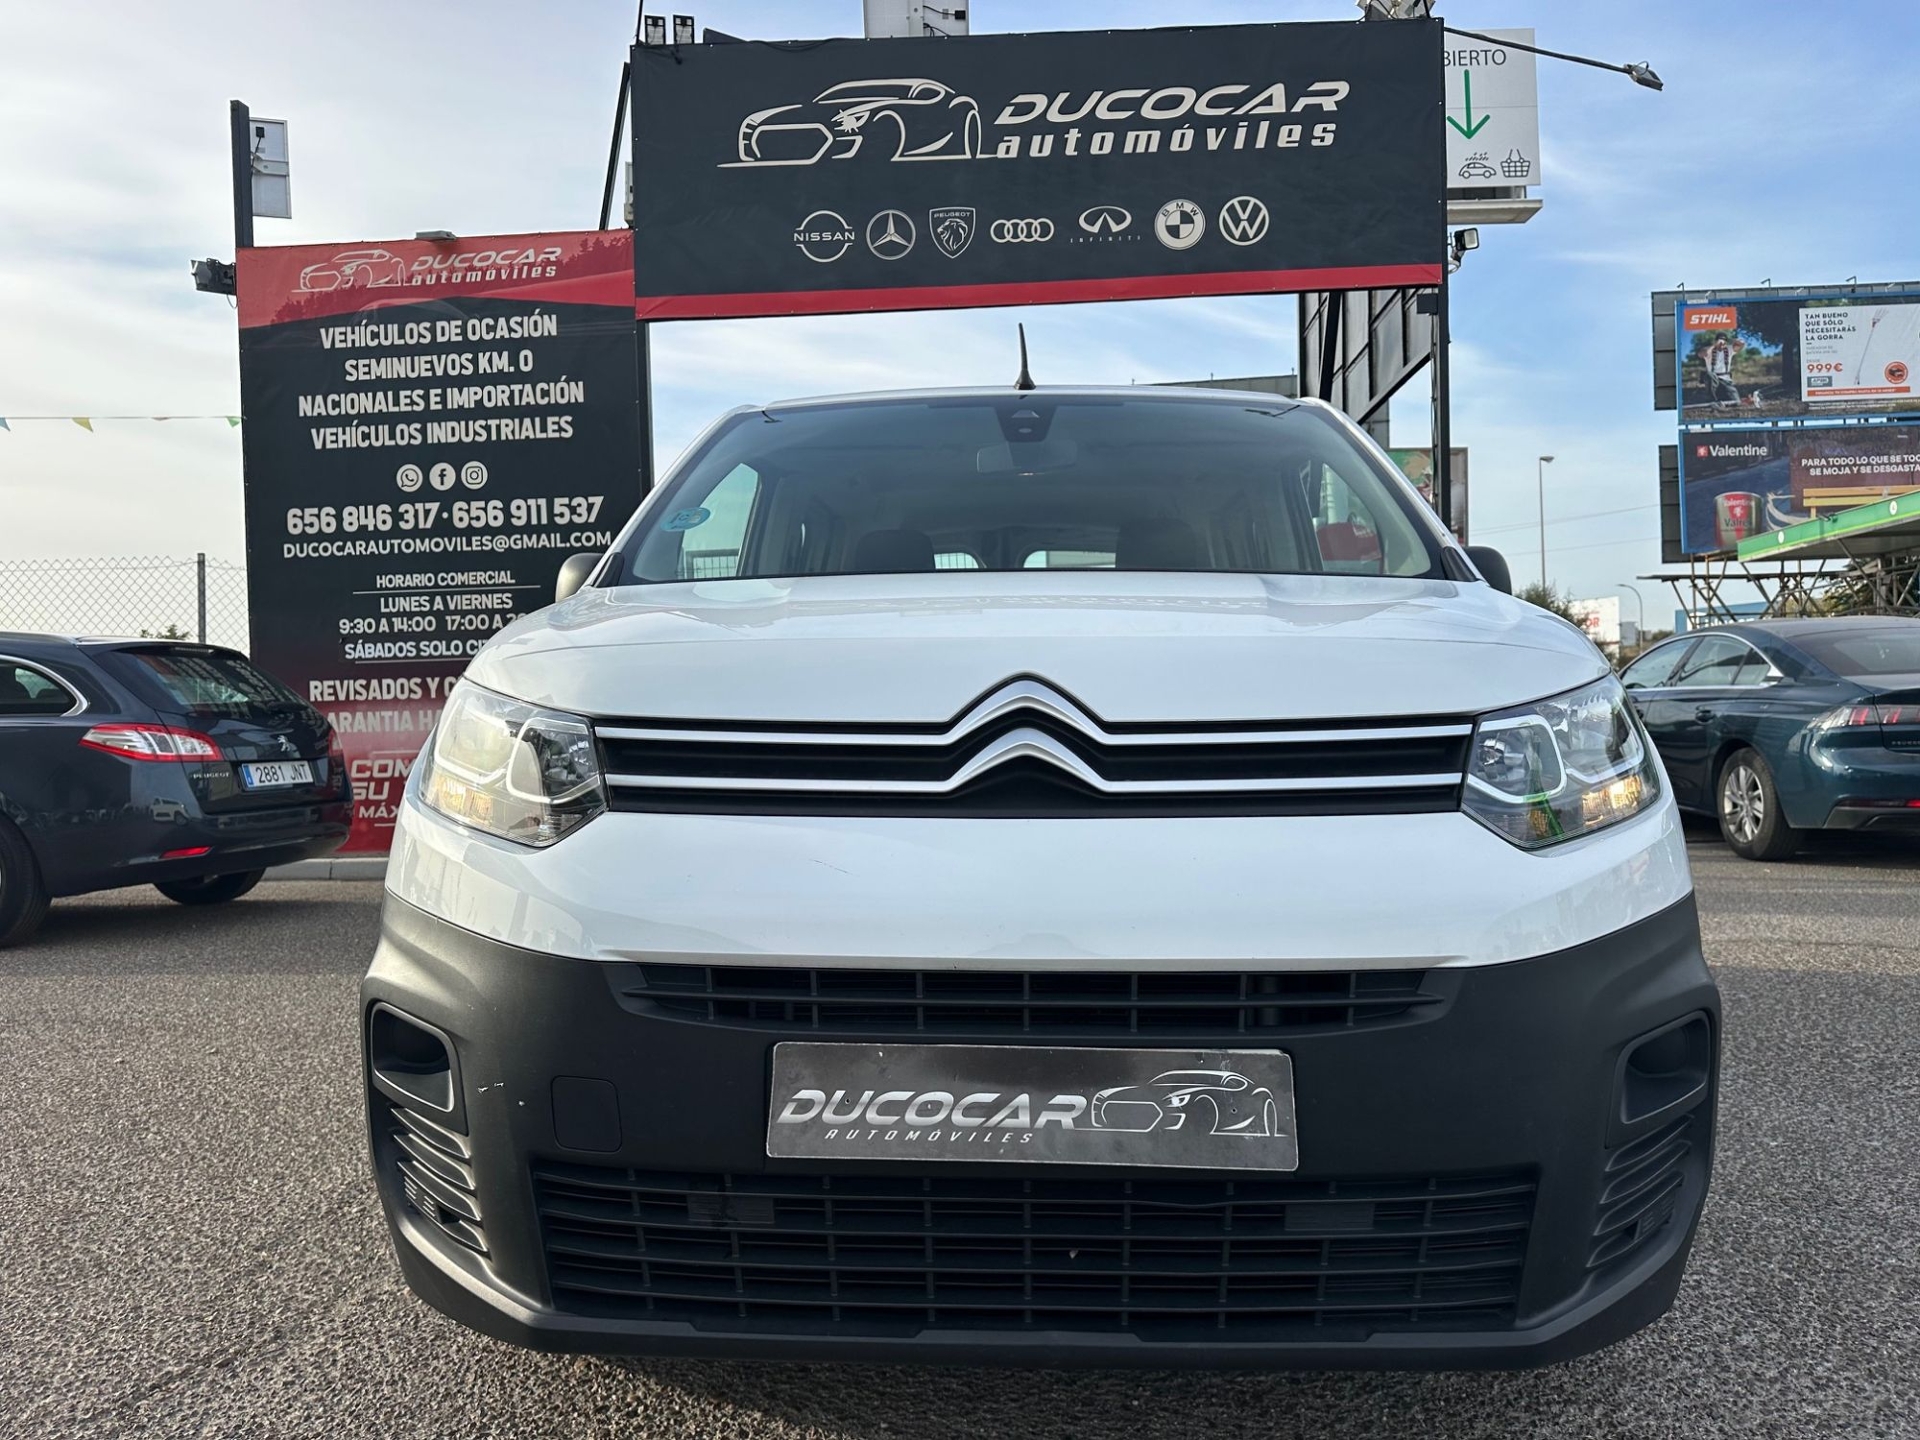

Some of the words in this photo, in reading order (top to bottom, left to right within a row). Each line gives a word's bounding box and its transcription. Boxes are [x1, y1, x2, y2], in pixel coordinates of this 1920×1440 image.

[994, 80, 1350, 125] DUCOCAR
[998, 120, 1336, 159] automóviles
[1161, 202, 1199, 217] BMW
[793, 231, 855, 242] NISSAN
[1070, 235, 1141, 243] INFINITI
[411, 247, 562, 271] DUCOCAR
[411, 263, 557, 286] automóviles
[320, 319, 431, 349] VEHÍCULOS
[436, 320, 462, 343] DE
[467, 309, 557, 341] OCASIÓN
[1690, 313, 1731, 325] STIHL
[1805, 325, 1856, 334] NECESITARÁS
[344, 352, 473, 381] SEMINUEVOS
[478, 351, 515, 374] KM.
[1807, 363, 1843, 373] 999€
[299, 389, 425, 417] NACIONALES
[429, 388, 442, 411] E
[447, 375, 585, 409] IMPORTACIÓN
[311, 419, 422, 450] VEHÍCULOS
[427, 416, 573, 444] INDUSTRIALES
[1709, 444, 1767, 457] Valentine
[1801, 458, 1827, 467] PARA
[1828, 457, 1855, 466] TODO
[1856, 456, 1868, 464] LO
[1869, 455, 1889, 465] QUE
[1890, 455, 1902, 463] SE
[1809, 468, 1822, 476] SE
[1823, 466, 1851, 475] MOJA
[1852, 466, 1859, 474] Y
[1860, 465, 1872, 473] SE
[286, 506, 337, 535] 656
[342, 504, 393, 532] 846
[510, 498, 548, 527] 911
[553, 495, 605, 525] 537
[283, 531, 612, 559] DUCOCARAUTOMOVILES@GMAIL.COM
[376, 573, 435, 588] HORARIO
[437, 570, 516, 586] COMERCIAL
[380, 595, 430, 613] LUNES
[432, 596, 444, 611] A
[446, 593, 513, 610] VIERNES
[339, 618, 376, 634] 9:30
[378, 618, 390, 633] A
[392, 616, 436, 632] 14:00
[445, 614, 490, 631] 17:00
[492, 614, 503, 629] A
[345, 640, 416, 659] SÁBADOS
[420, 639, 463, 656] SOLO
[309, 677, 422, 702] REVISADOS
[426, 676, 440, 699] Y
[256, 765, 286, 783] 2881
[290, 764, 308, 780] JNT
[777, 1089, 1088, 1130] DUCOCAR
[825, 1129, 1034, 1144] AUTOMÓVILES
